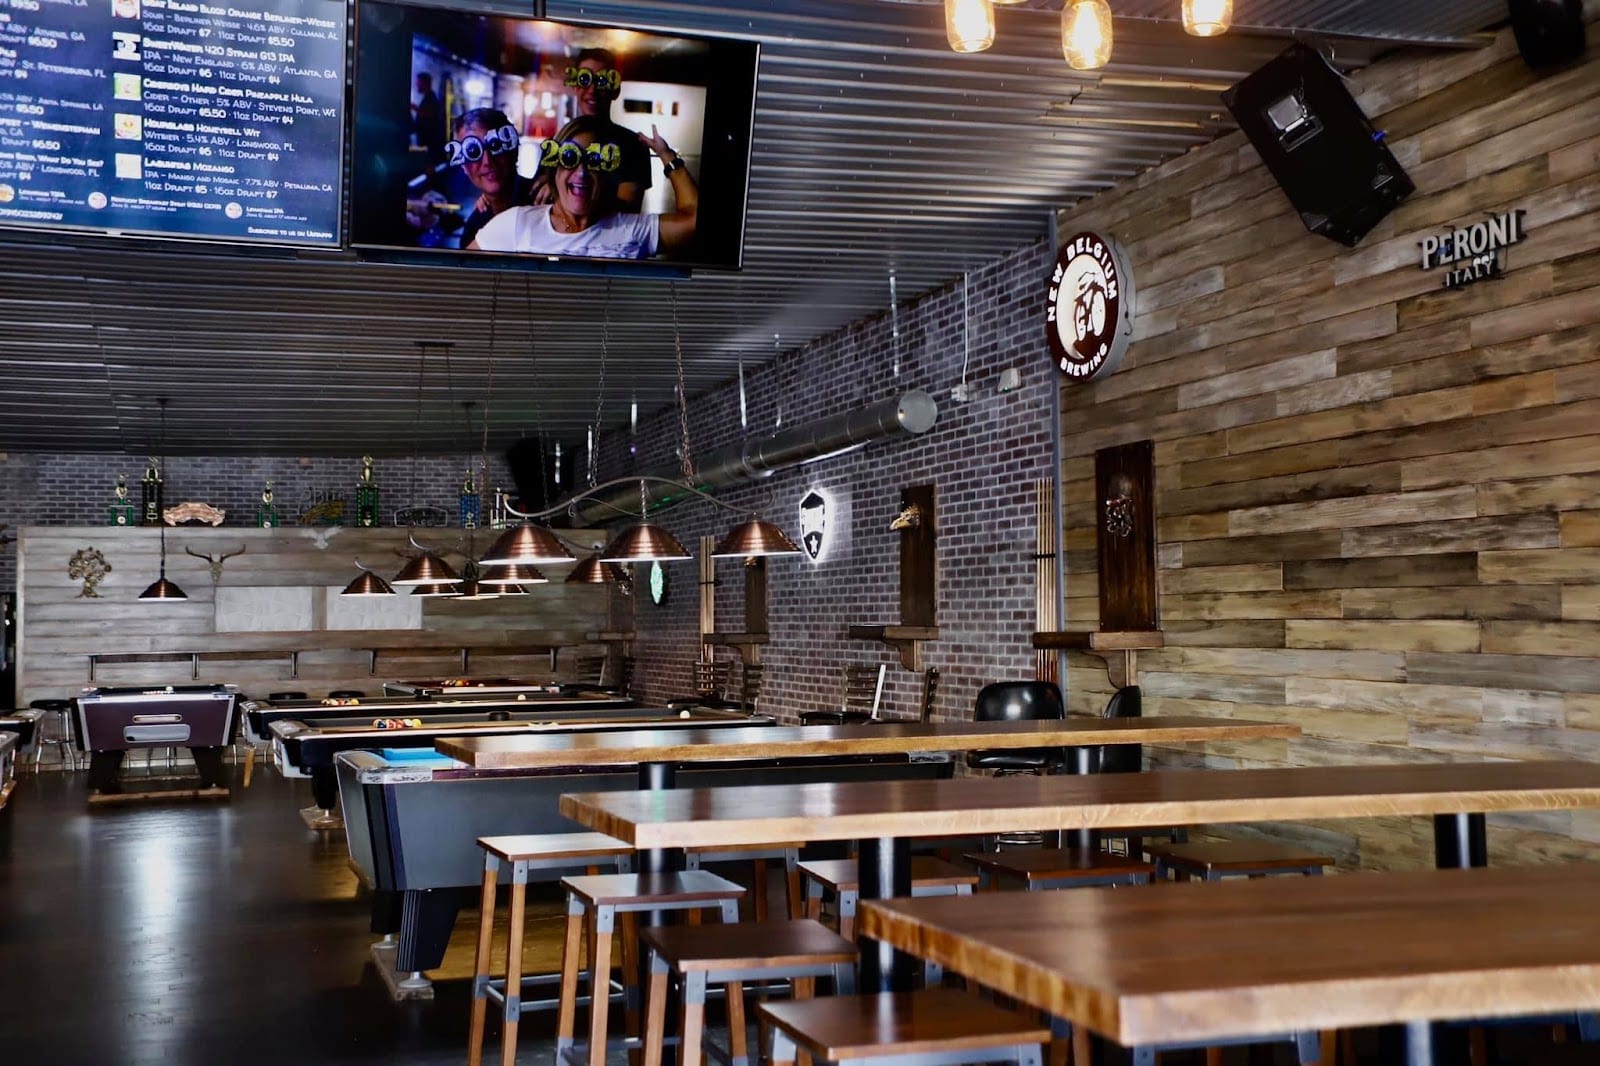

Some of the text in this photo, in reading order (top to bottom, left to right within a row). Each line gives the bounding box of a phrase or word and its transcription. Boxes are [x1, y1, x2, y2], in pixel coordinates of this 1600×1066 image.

[199, 28, 211, 38] $7
[268, 25, 285, 34] ABV
[205, 46, 224, 56] 420
[260, 52, 276, 60] G13
[279, 54, 295, 63] IPA
[144, 50, 161, 60] IPA
[257, 63, 276, 72] ABV
[324, 70, 337, 79] GA
[232, 100, 252, 109] ABV
[210, 136, 230, 146] ABV
[145, 170, 159, 178] IPA
[264, 180, 279, 188] ABV
[1422, 211, 1518, 270] PERONI
[1048, 236, 1118, 322] NEW BELGIUM
[1446, 262, 1492, 287] ITALY
[1060, 342, 1108, 376] BREWING
